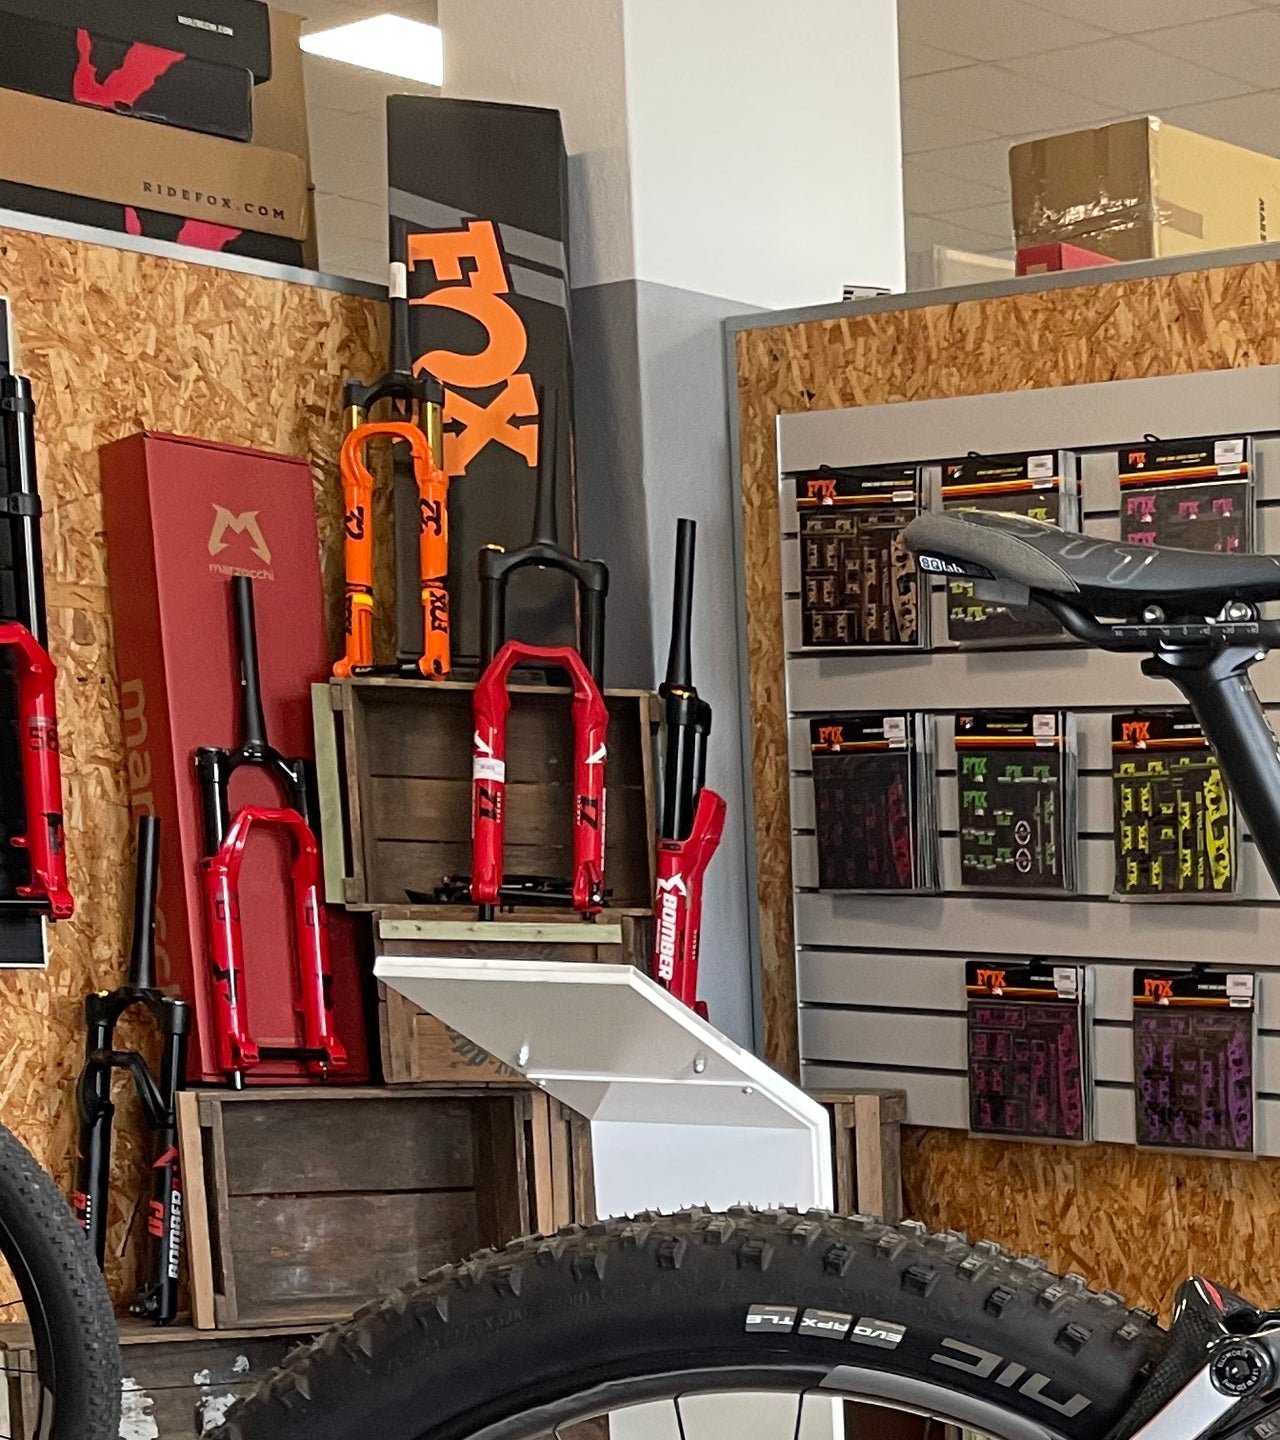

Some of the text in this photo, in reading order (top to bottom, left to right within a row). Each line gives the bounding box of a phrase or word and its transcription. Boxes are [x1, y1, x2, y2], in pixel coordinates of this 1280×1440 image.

[142, 181, 285, 220] RIDEFOX.COM
[407, 220, 540, 476] FOX
[1121, 721, 1151, 750] FOX
[658, 893, 677, 982] BOMBER
